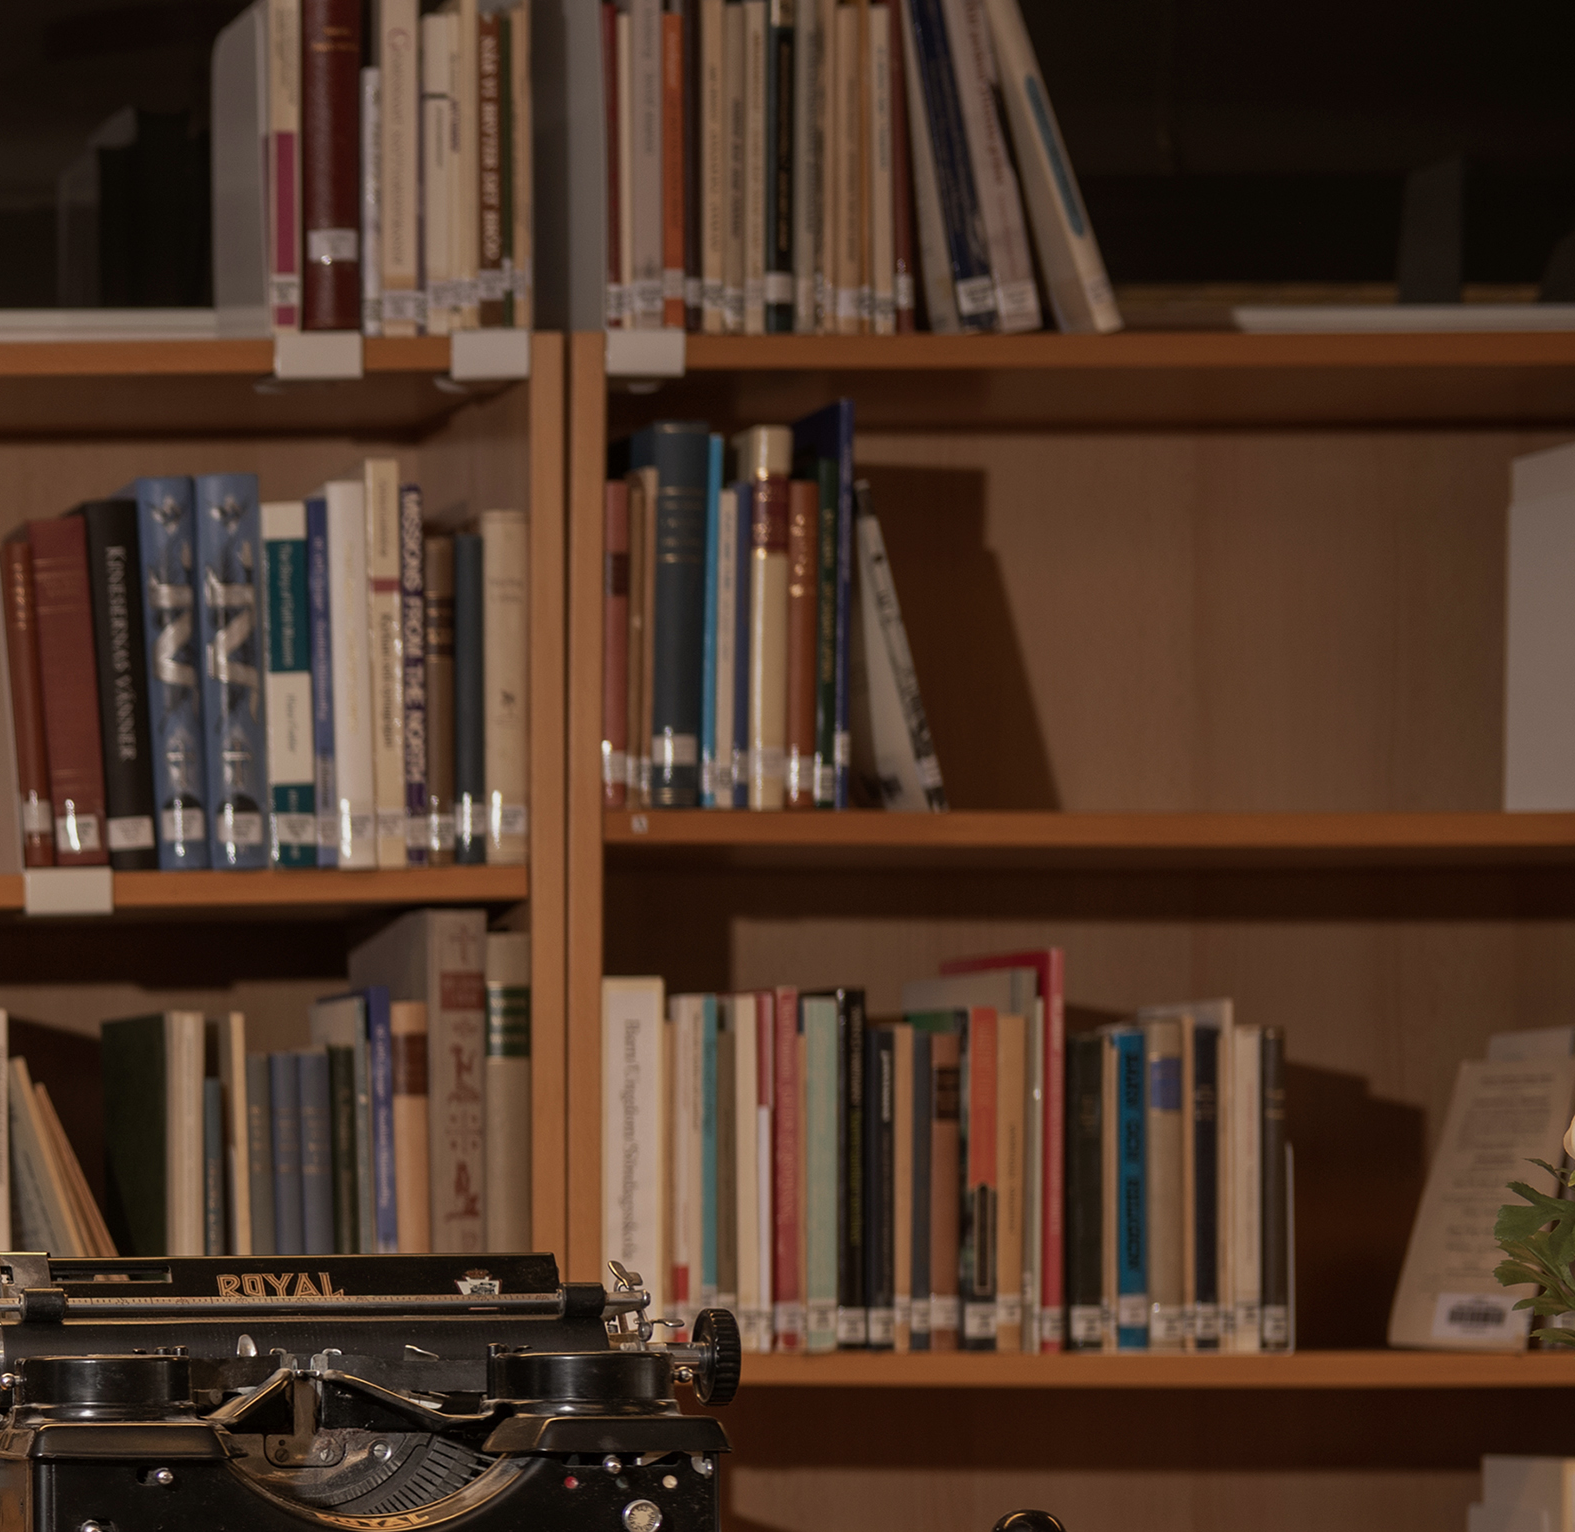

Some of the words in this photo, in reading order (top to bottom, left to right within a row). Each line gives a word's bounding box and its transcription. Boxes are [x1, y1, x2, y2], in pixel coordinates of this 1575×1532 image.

[402, 489, 425, 592] MISSIONS
[105, 545, 132, 673] KINESERNAS
[402, 596, 425, 659] FROM
[113, 675, 138, 762] VÄNNER
[402, 662, 425, 705] THE
[404, 708, 425, 785] NORTH
[215, 1272, 345, 1298] ROYAL
[313, 1511, 429, 1529] ROYAL
